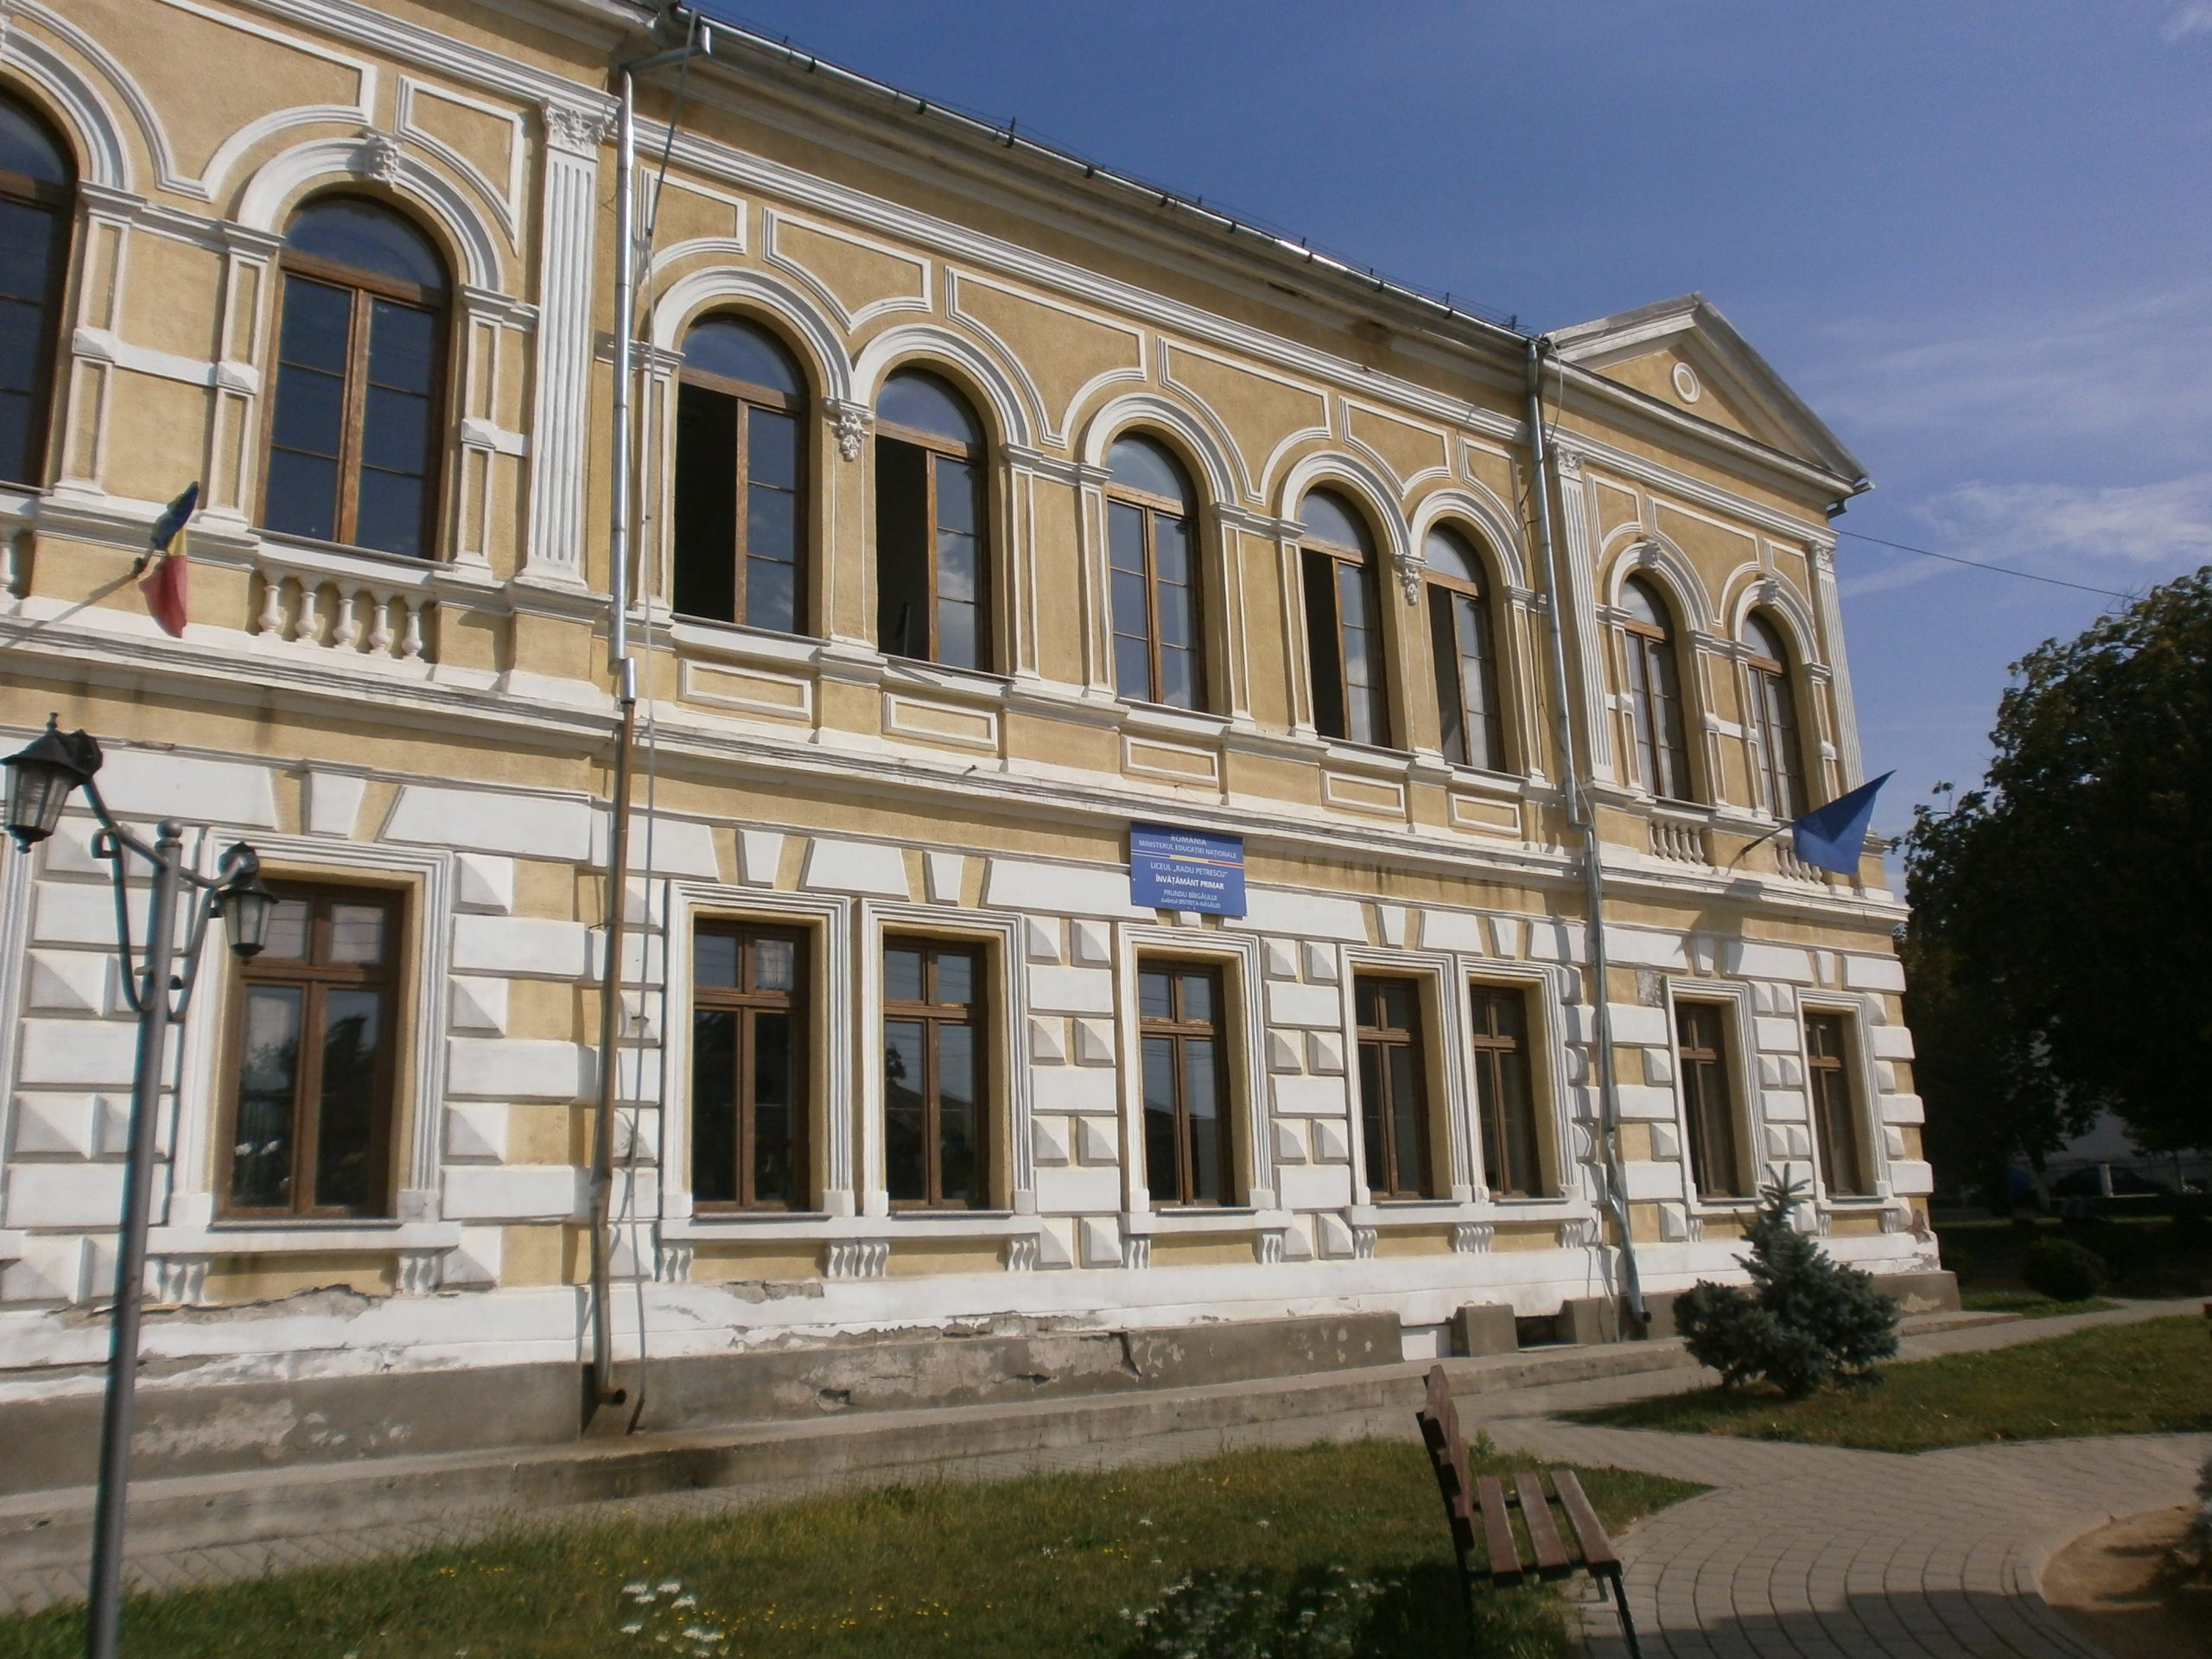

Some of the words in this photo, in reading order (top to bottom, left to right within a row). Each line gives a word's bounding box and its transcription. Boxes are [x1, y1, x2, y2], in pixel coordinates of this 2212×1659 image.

[1139, 840, 1173, 849] MINISTERUL
[1151, 861, 1172, 871] LICEUL
[1200, 880, 1224, 890] PRIMAR
[1163, 889, 1187, 898] PRUNDU
